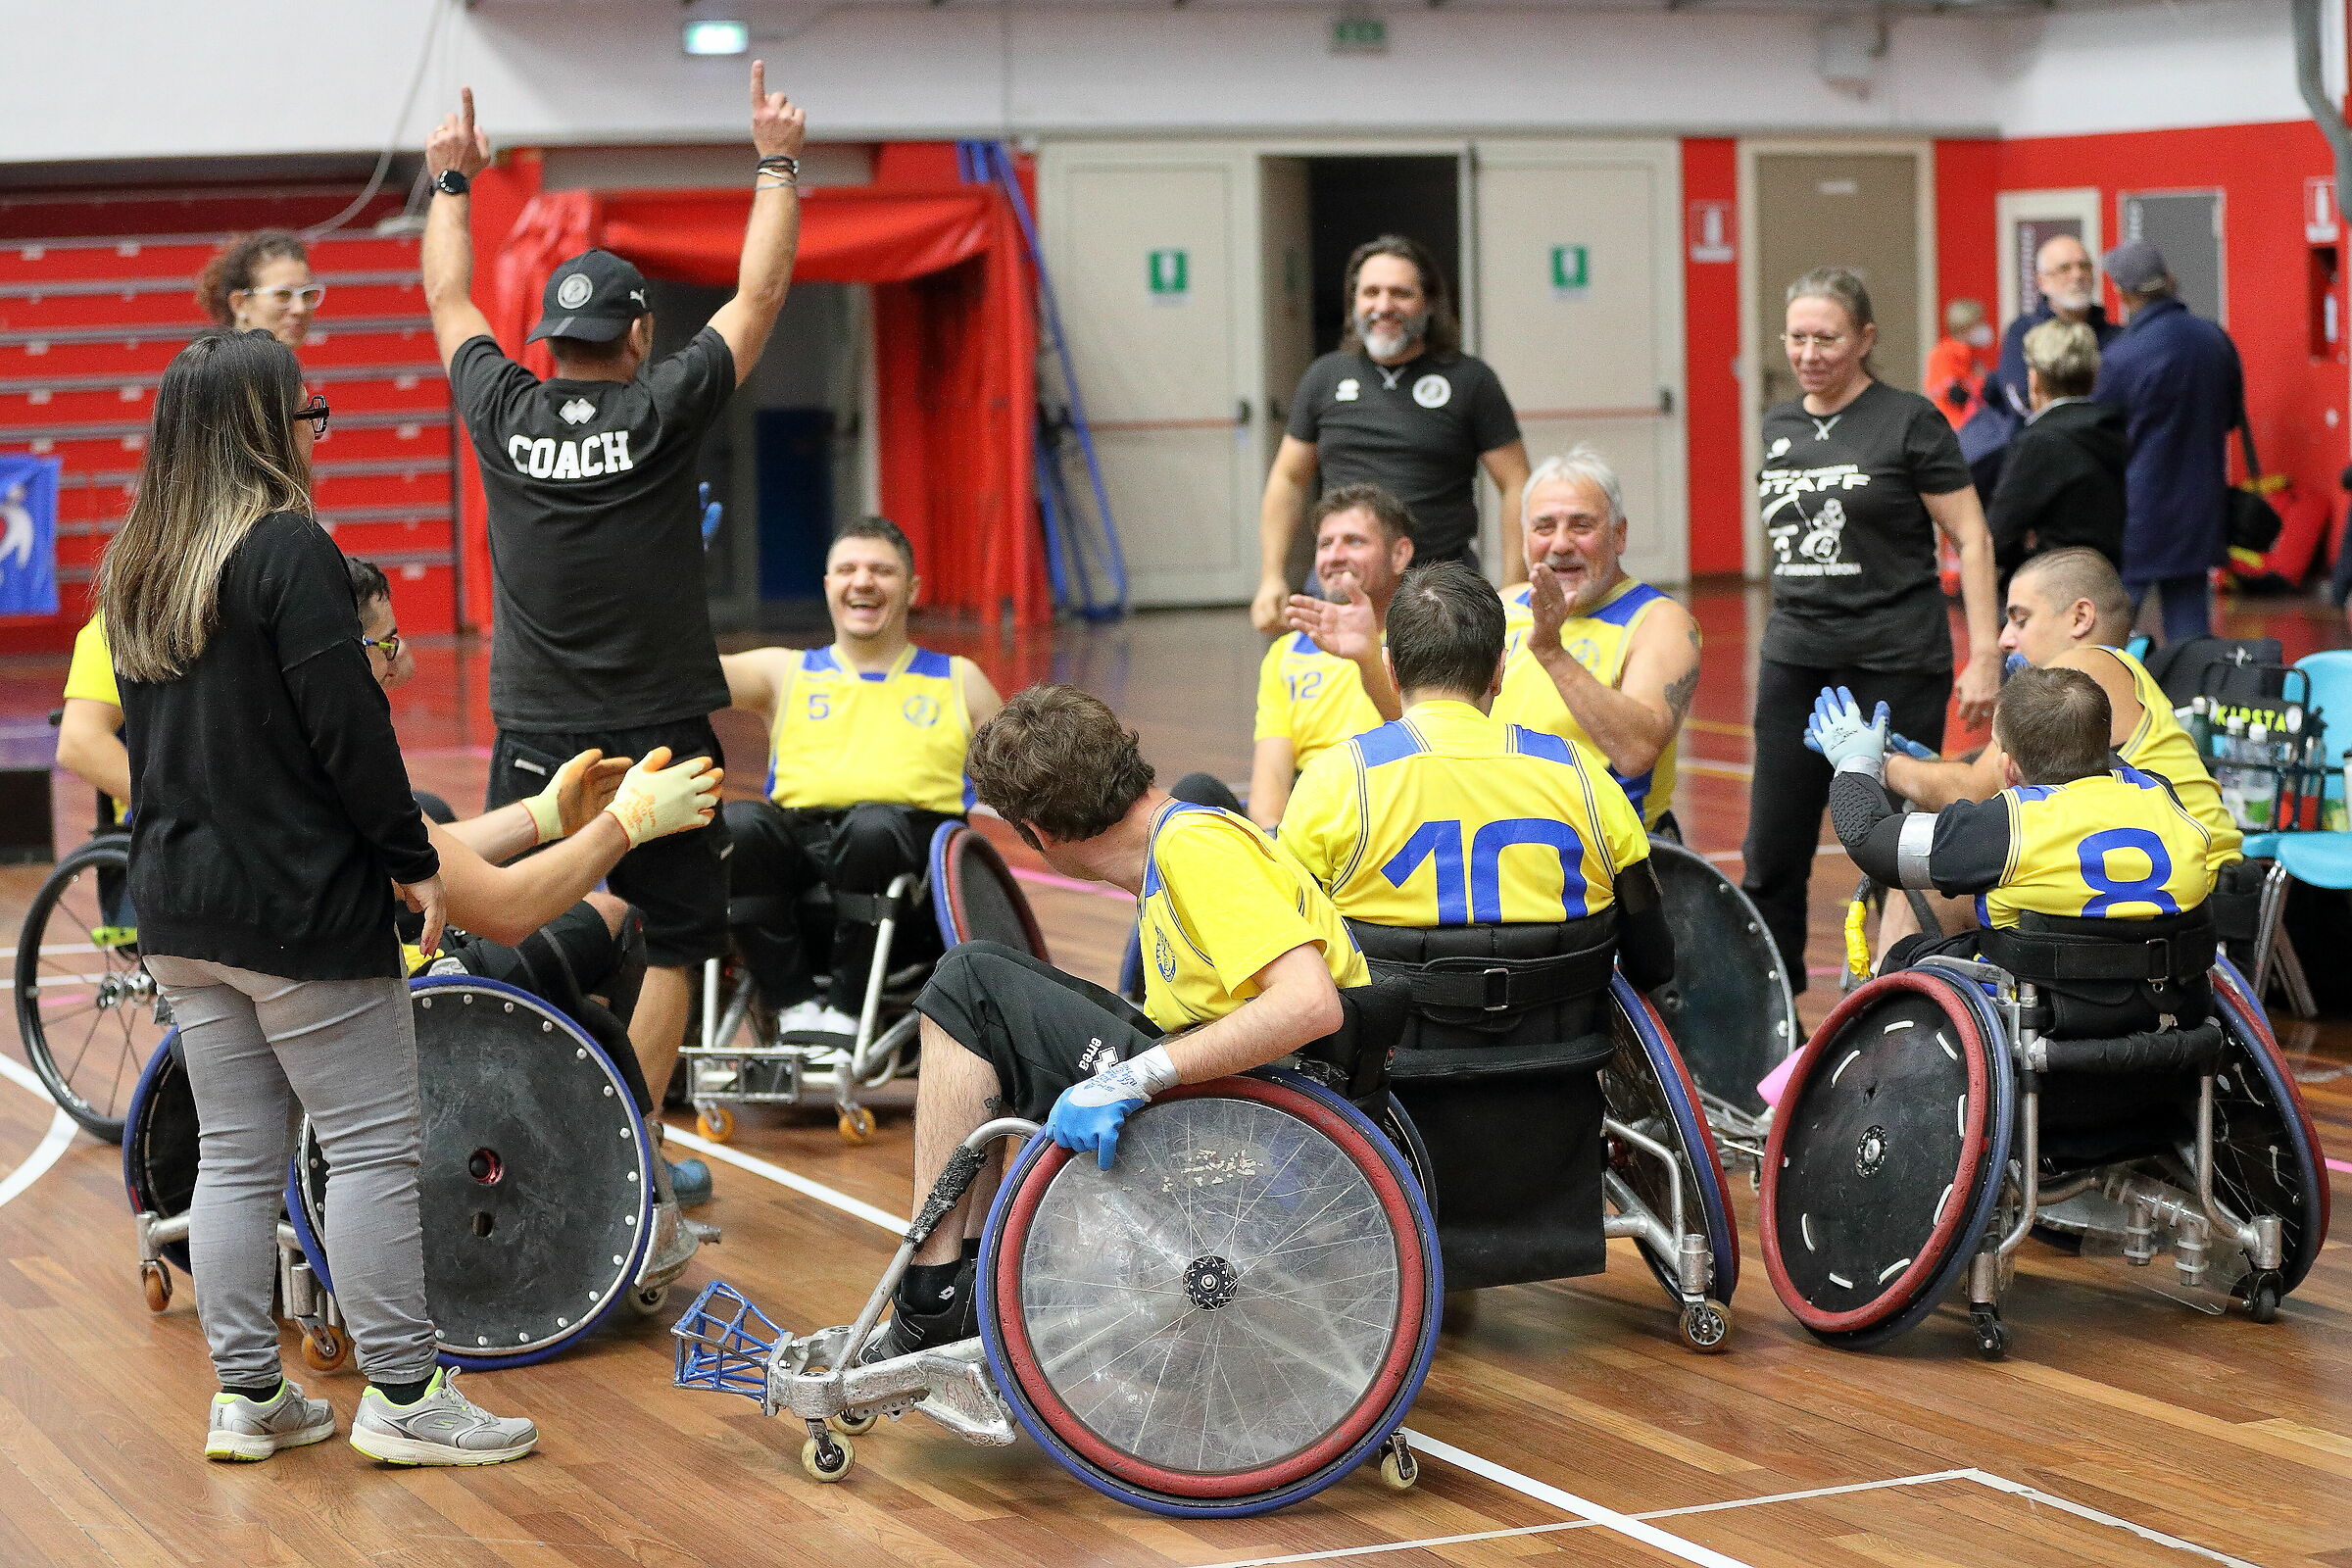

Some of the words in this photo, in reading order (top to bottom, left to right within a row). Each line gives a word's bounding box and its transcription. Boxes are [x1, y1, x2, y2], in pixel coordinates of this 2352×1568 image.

[508, 430, 634, 479] COACH
[808, 694, 831, 720] 5
[1288, 670, 1323, 703] 12
[1380, 817, 1590, 926] 10
[2077, 827, 2182, 918] 8
